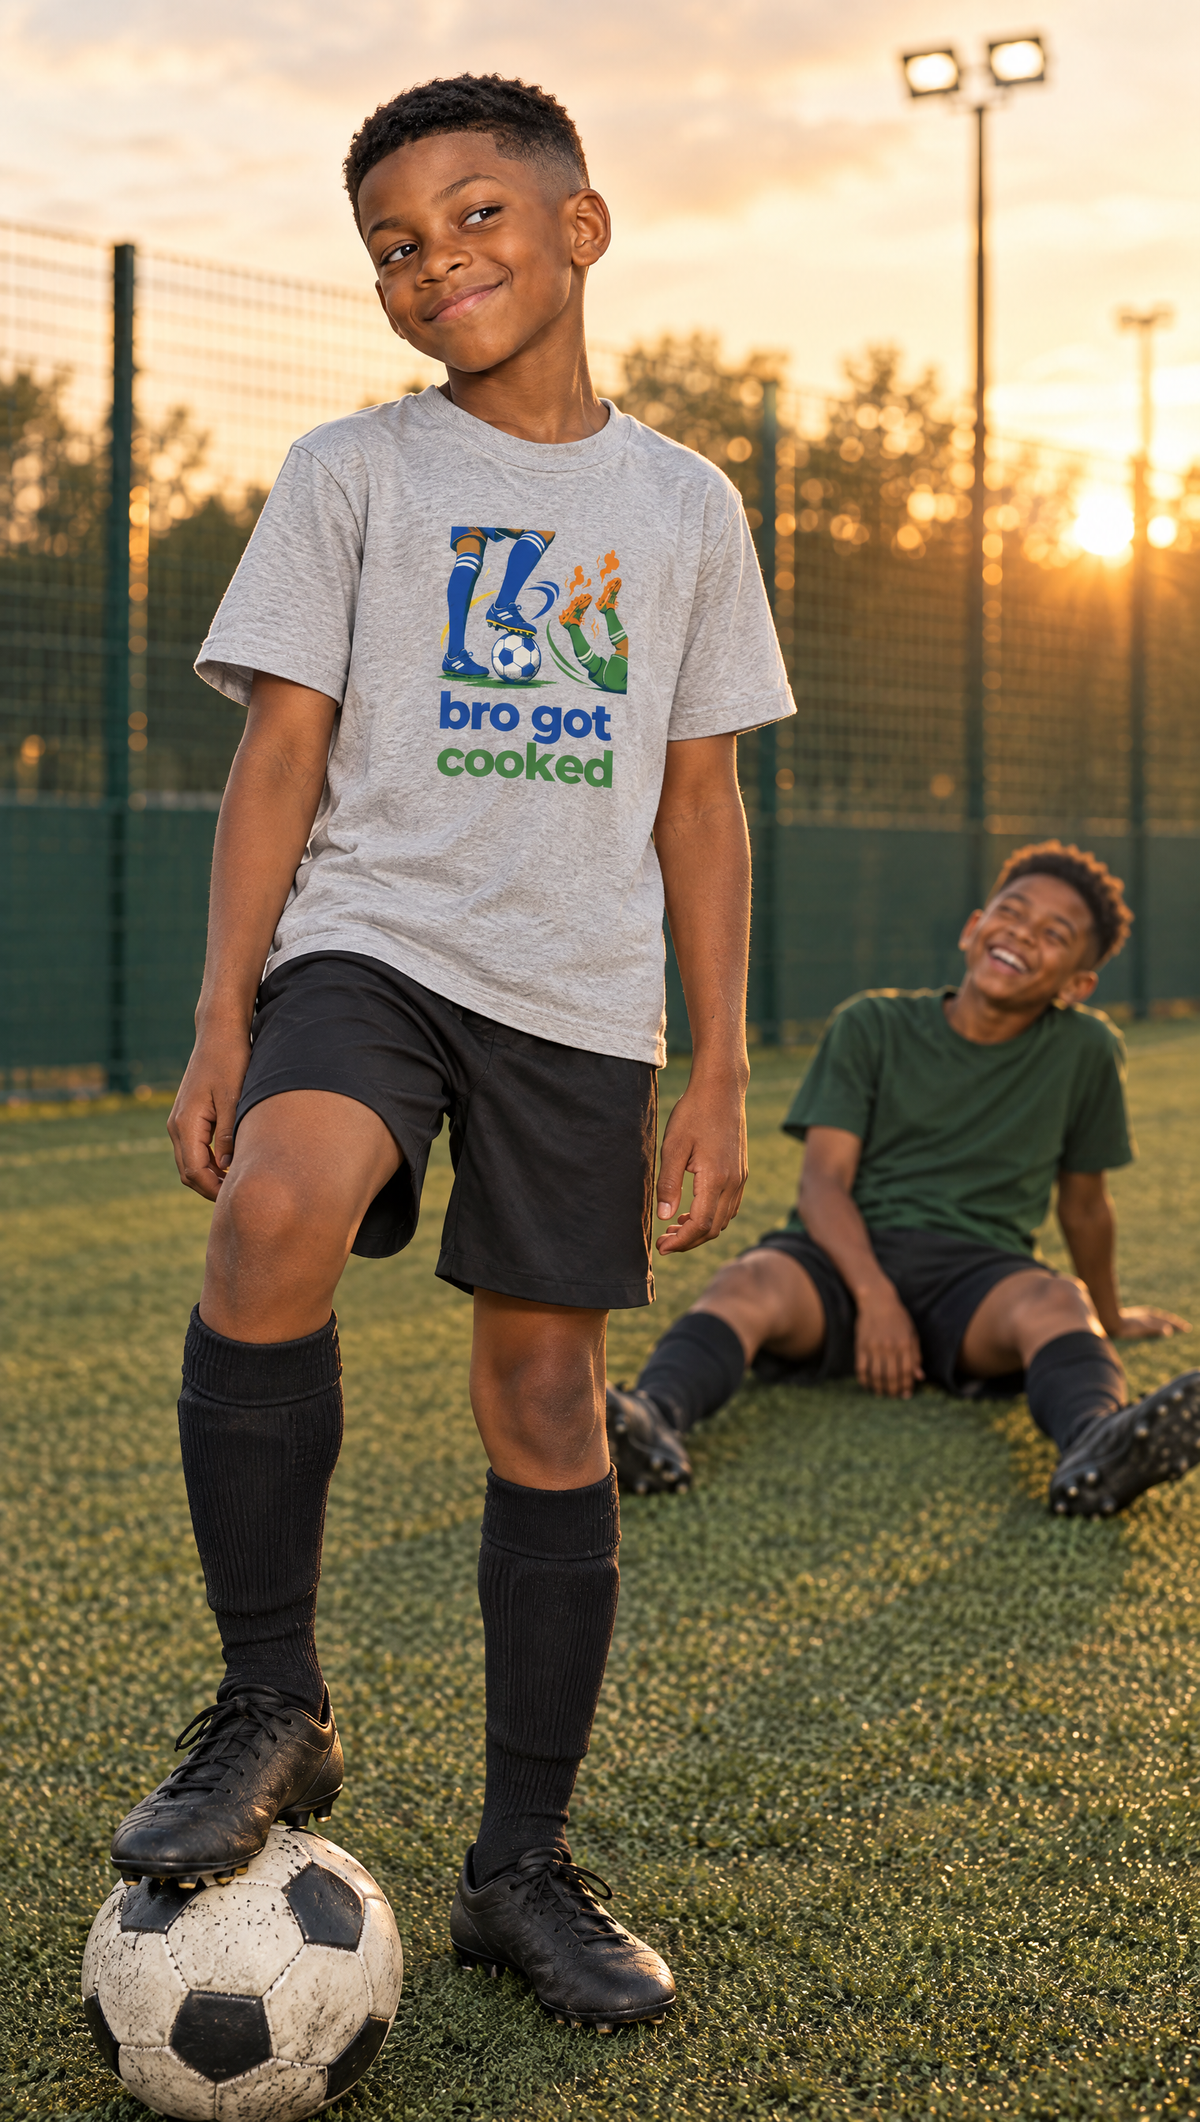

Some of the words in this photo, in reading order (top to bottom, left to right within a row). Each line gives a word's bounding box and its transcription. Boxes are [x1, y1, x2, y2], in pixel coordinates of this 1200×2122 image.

[439, 691, 520, 731] bro
[531, 705, 612, 744] got
[437, 742, 613, 788] cooked
